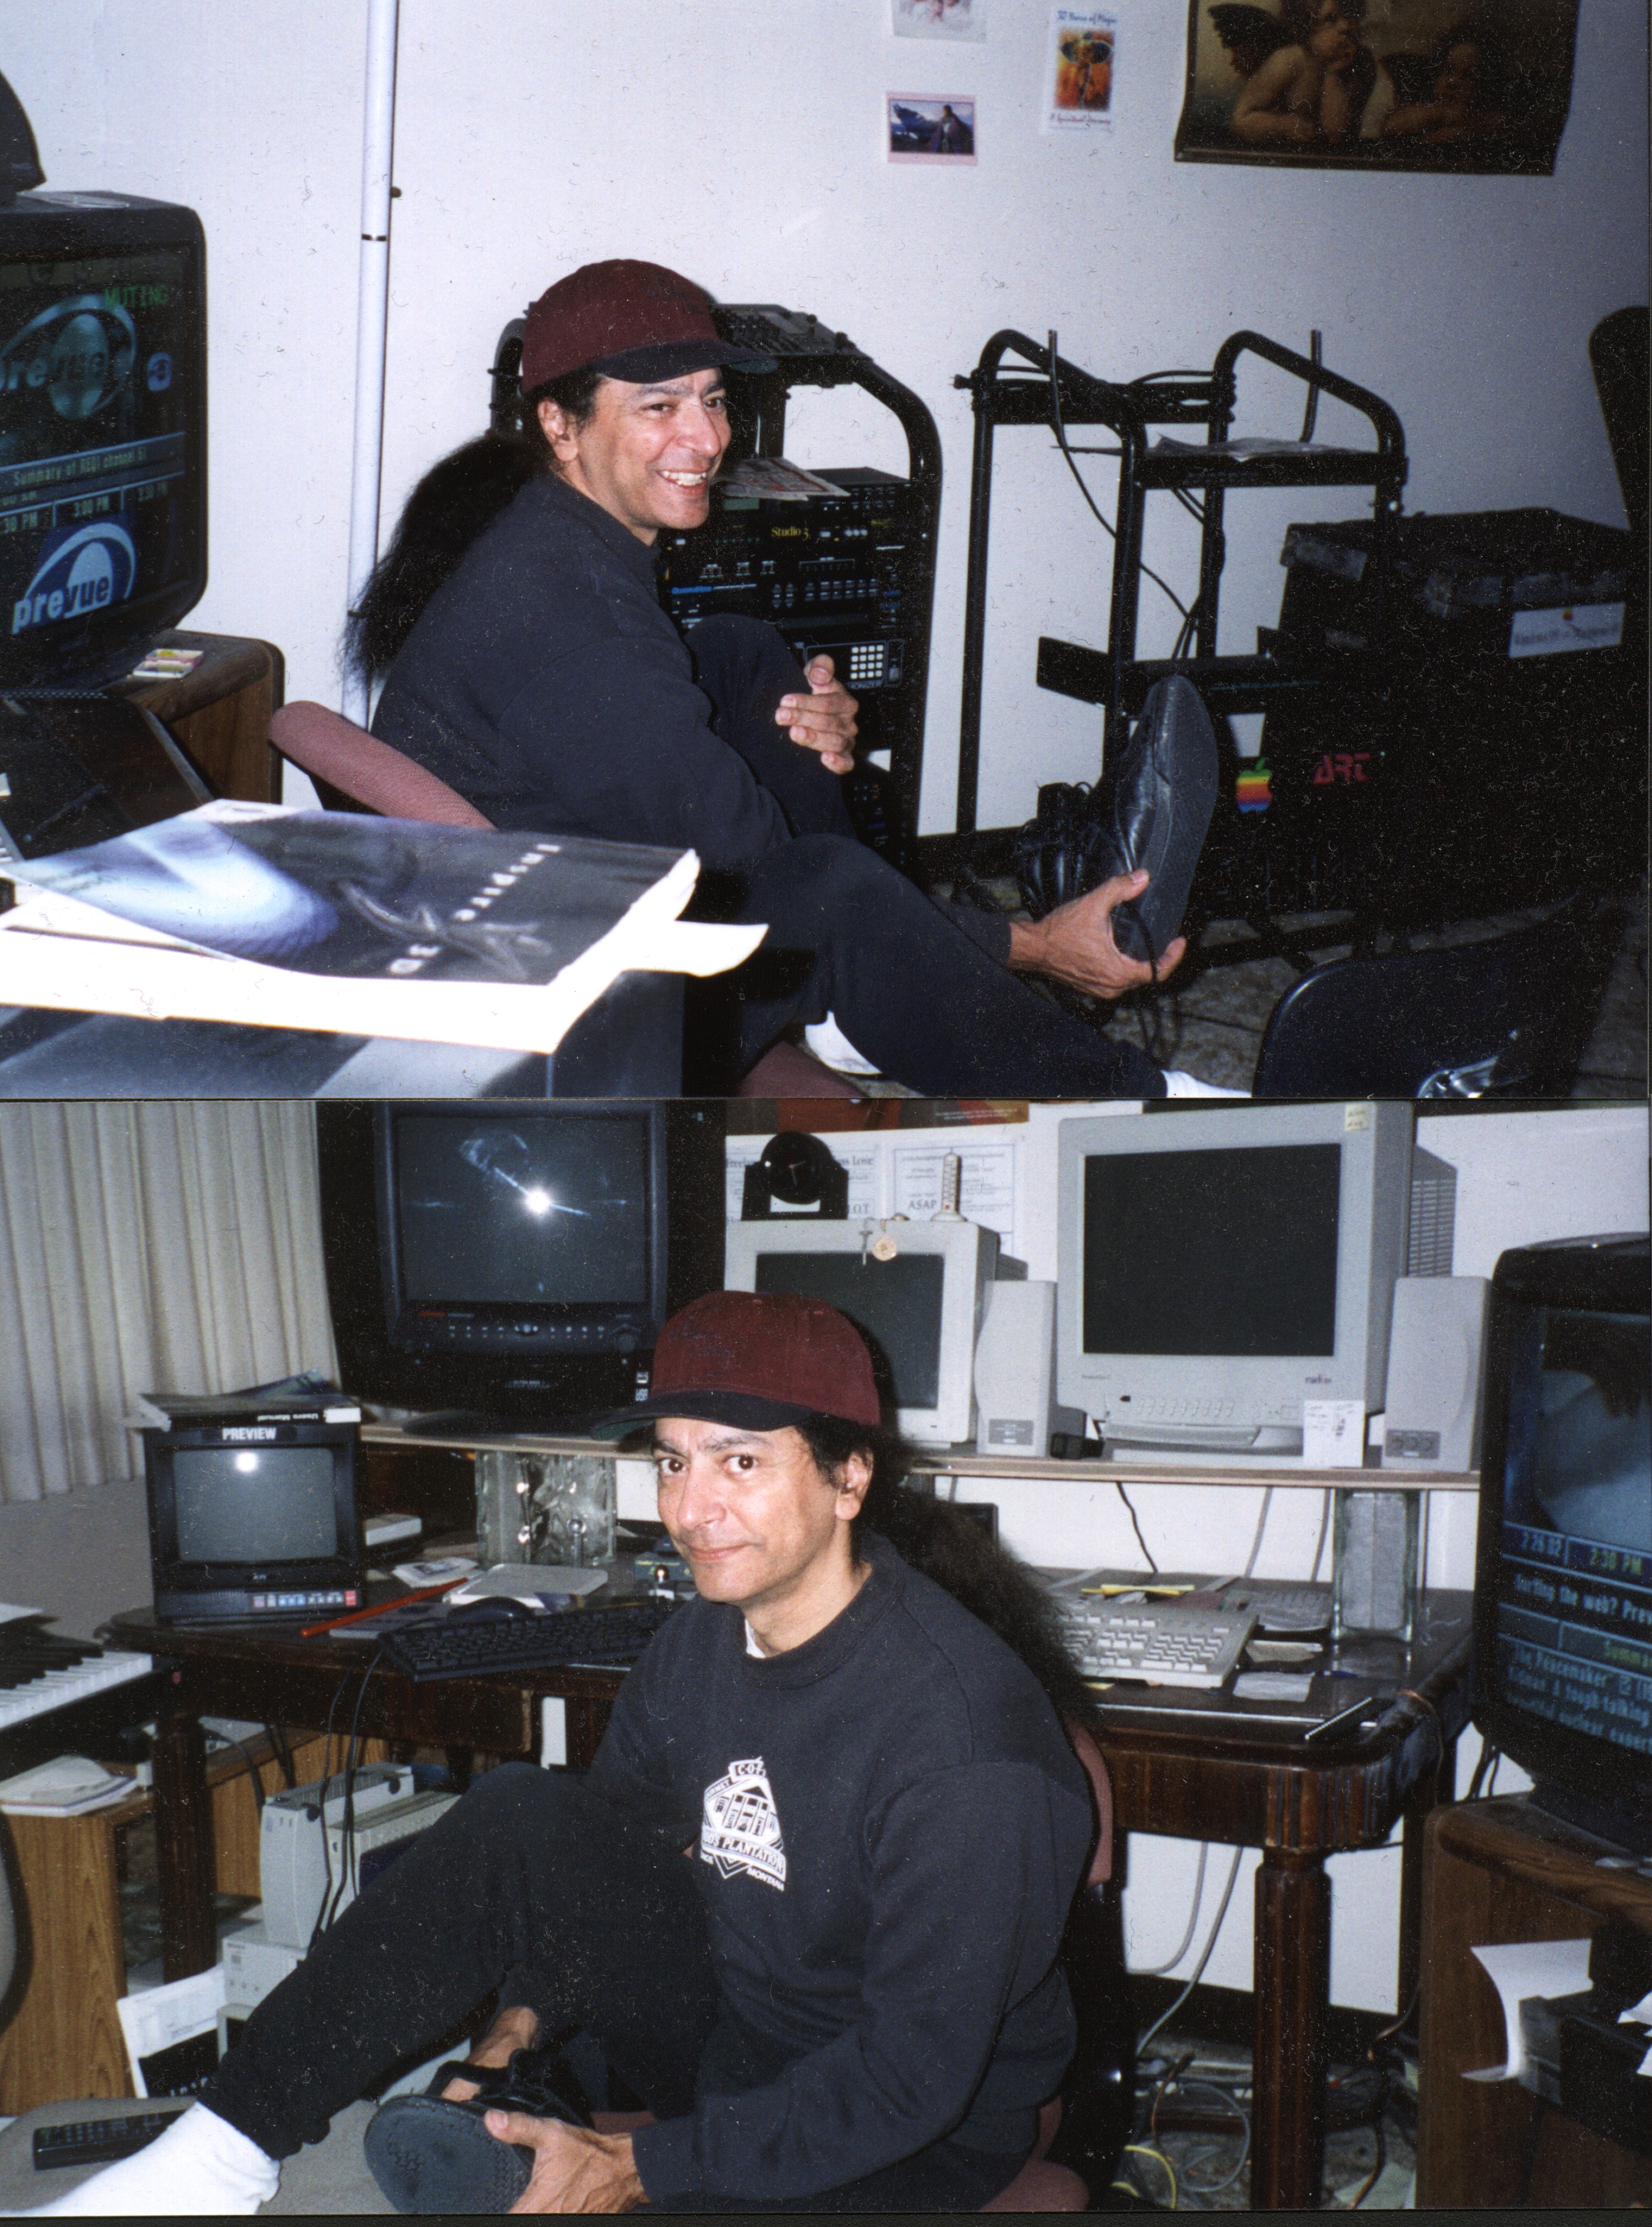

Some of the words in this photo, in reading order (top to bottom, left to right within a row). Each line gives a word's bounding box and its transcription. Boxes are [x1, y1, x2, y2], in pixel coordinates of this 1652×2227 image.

[771, 526, 801, 537] Studio
[802, 527, 810, 542] 3
[12, 576, 111, 634] prevue
[909, 1199, 937, 1210] ASAP
[222, 1427, 276, 1440] PREVIEW
[722, 1836, 784, 1874] PLANTATION
[747, 1866, 784, 1892] MONTANA
